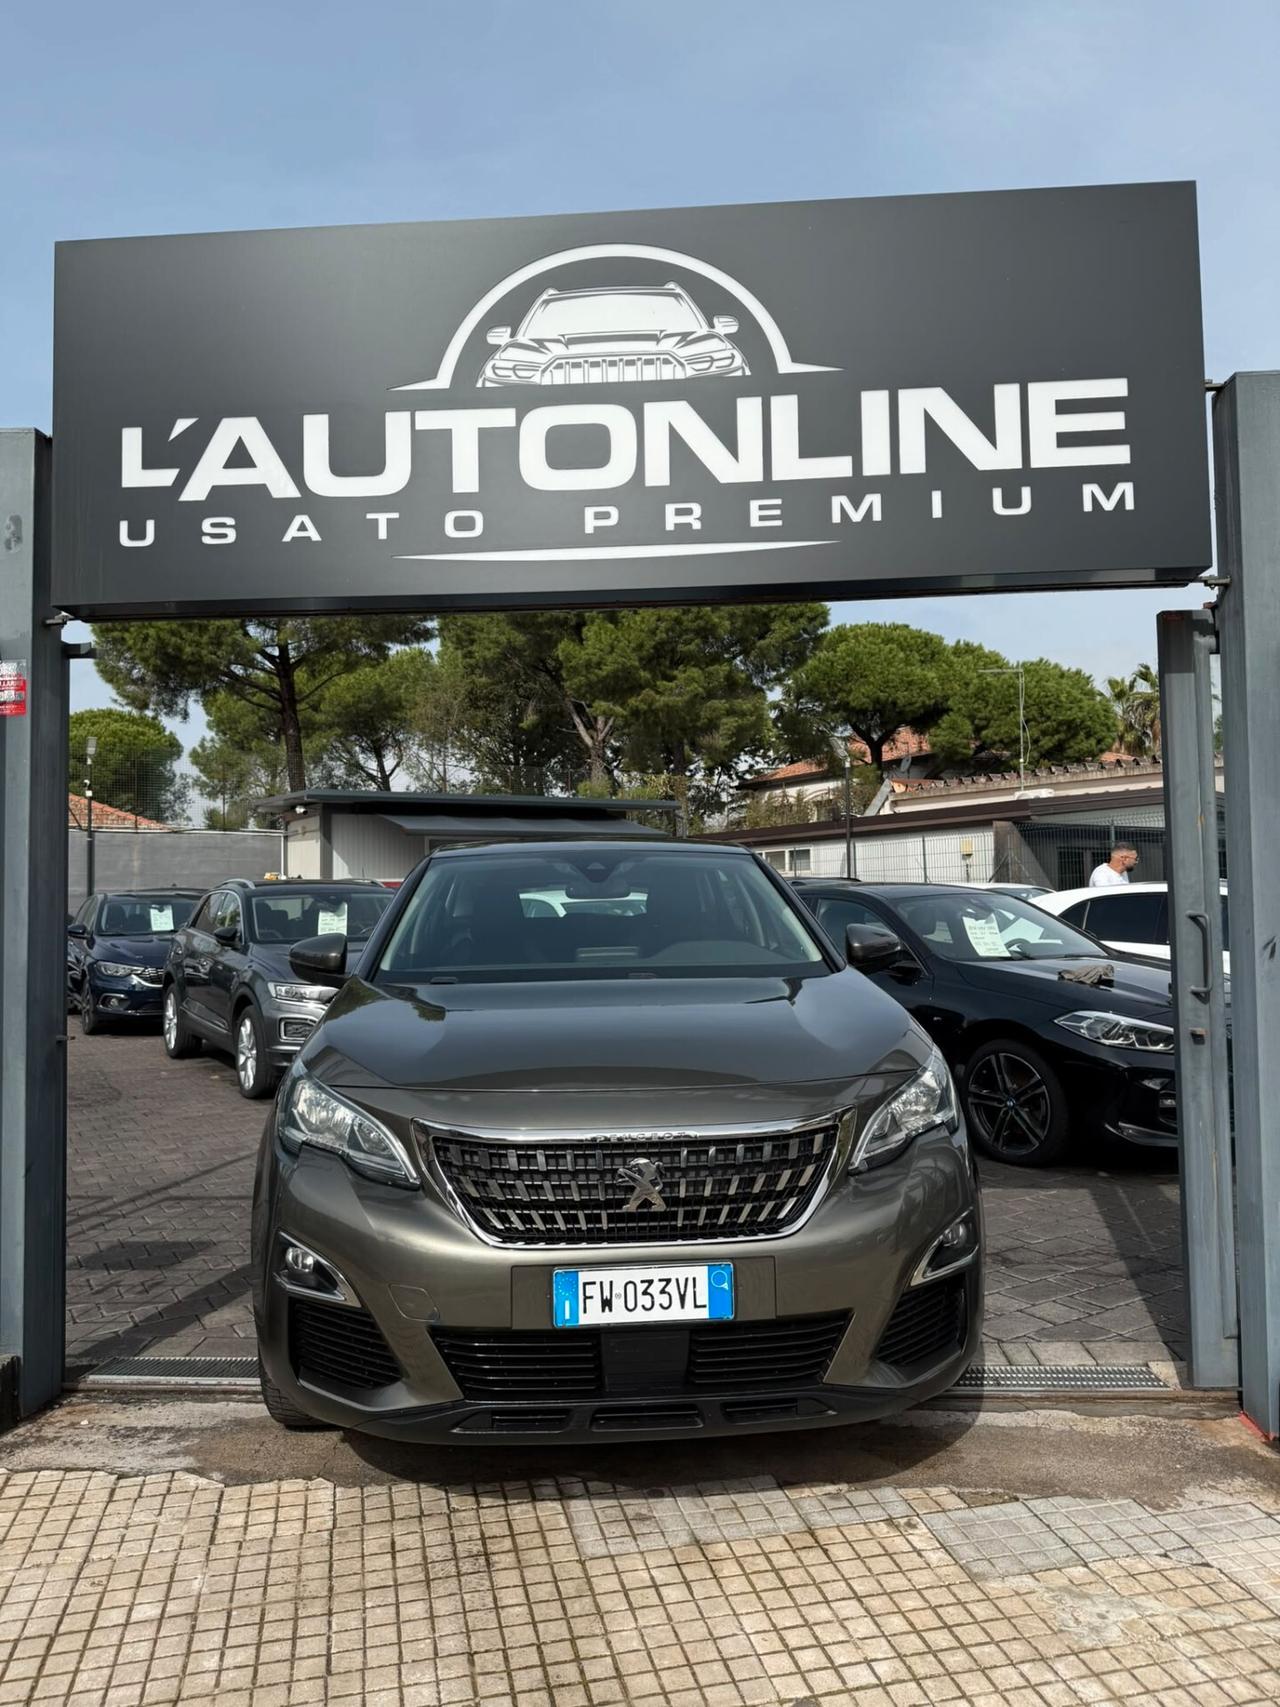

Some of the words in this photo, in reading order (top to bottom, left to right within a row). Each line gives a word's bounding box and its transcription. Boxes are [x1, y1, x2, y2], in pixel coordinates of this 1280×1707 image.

[120, 376, 1132, 502] L'AUTONLINE
[118, 508, 484, 548] USATO
[582, 480, 1136, 535] PREMIUM
[596, 1131, 687, 1143] PEUGEOT
